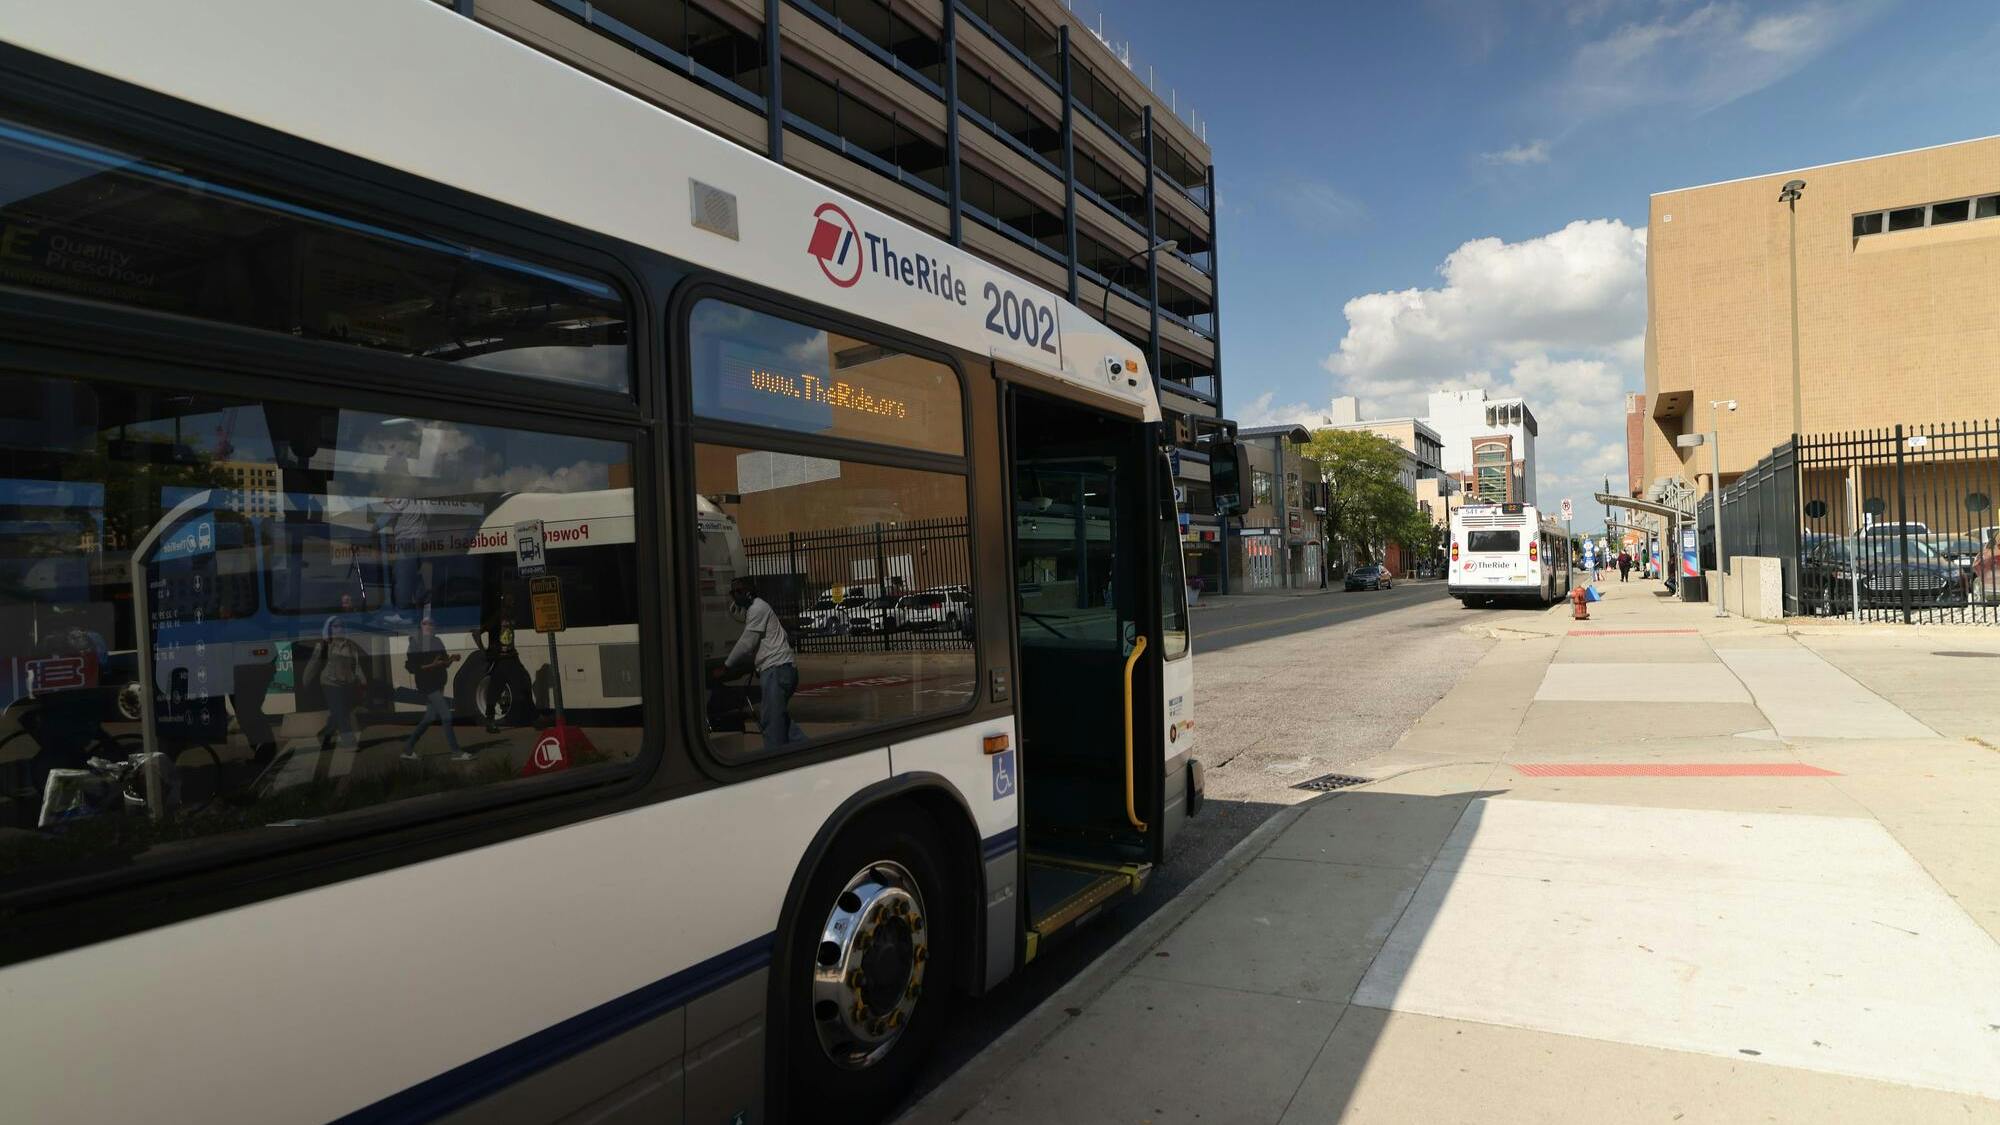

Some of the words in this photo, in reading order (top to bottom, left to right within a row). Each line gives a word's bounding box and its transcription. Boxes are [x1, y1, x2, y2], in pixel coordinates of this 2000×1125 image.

[864, 231, 967, 306] TheRide
[983, 281, 1057, 354] 2002
[752, 369, 906, 418] www.TheRide.org
[1478, 561, 1510, 569] TheRide
